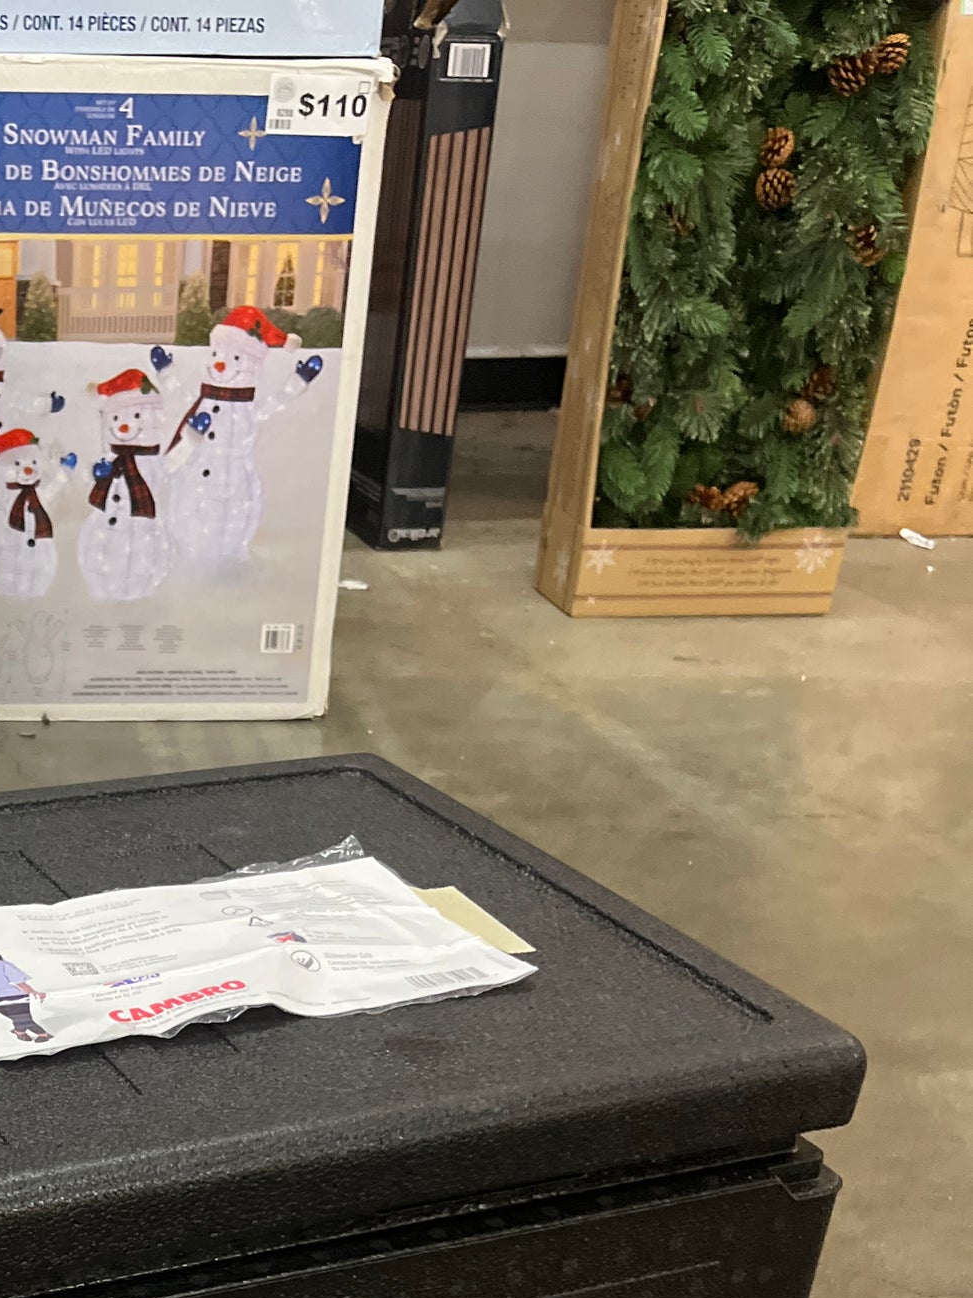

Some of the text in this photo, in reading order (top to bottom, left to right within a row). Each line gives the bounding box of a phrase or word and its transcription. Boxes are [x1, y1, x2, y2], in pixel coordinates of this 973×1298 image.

[12, 14, 19, 31] /
[23, 14, 63, 32] CONT.
[69, 15, 83, 31] 14
[88, 11, 136, 32] PIÈCES
[140, 15, 147, 32] /
[151, 16, 190, 33] CONT.
[197, 17, 211, 33] 14
[216, 17, 265, 34] PIEZAS
[118, 97, 134, 119] 4
[298, 92, 368, 120] $110
[3, 123, 206, 147] SNOWMAN FAMILY
[5, 165, 33, 180] DE
[41, 159, 191, 183] BONSHOMMES
[198, 166, 226, 182] DE
[234, 160, 302, 183] NEIGE
[25, 200, 53, 217] DE
[58, 195, 167, 218] MUÑECOS
[173, 201, 200, 217] DE
[208, 196, 277, 218] NIEVE
[924, 455, 948, 505] Futon
[108, 980, 246, 1023] CAMBRO
